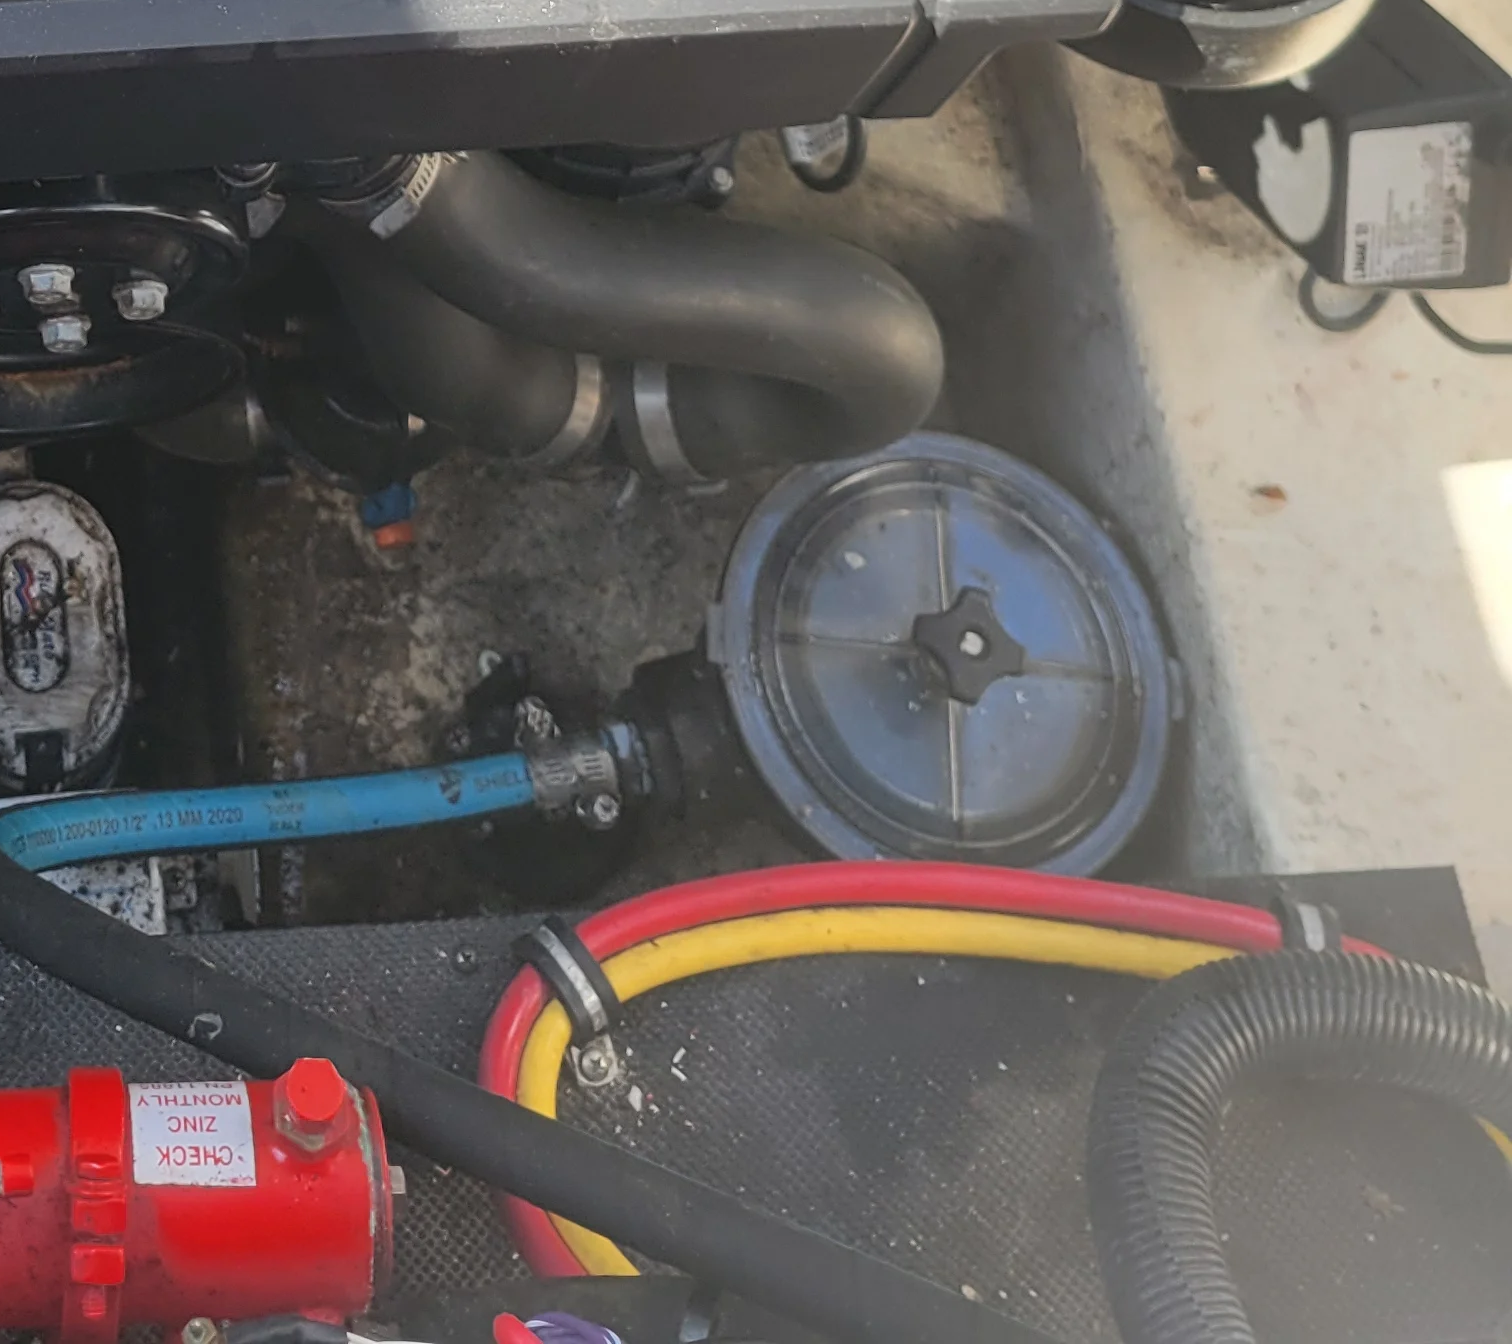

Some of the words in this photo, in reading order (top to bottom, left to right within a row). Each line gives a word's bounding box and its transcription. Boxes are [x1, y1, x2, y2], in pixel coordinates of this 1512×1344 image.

[136, 1093, 242, 1107] MONTHLY
[166, 1115, 218, 1133] ZINC
[156, 1144, 234, 1167] CHECK
